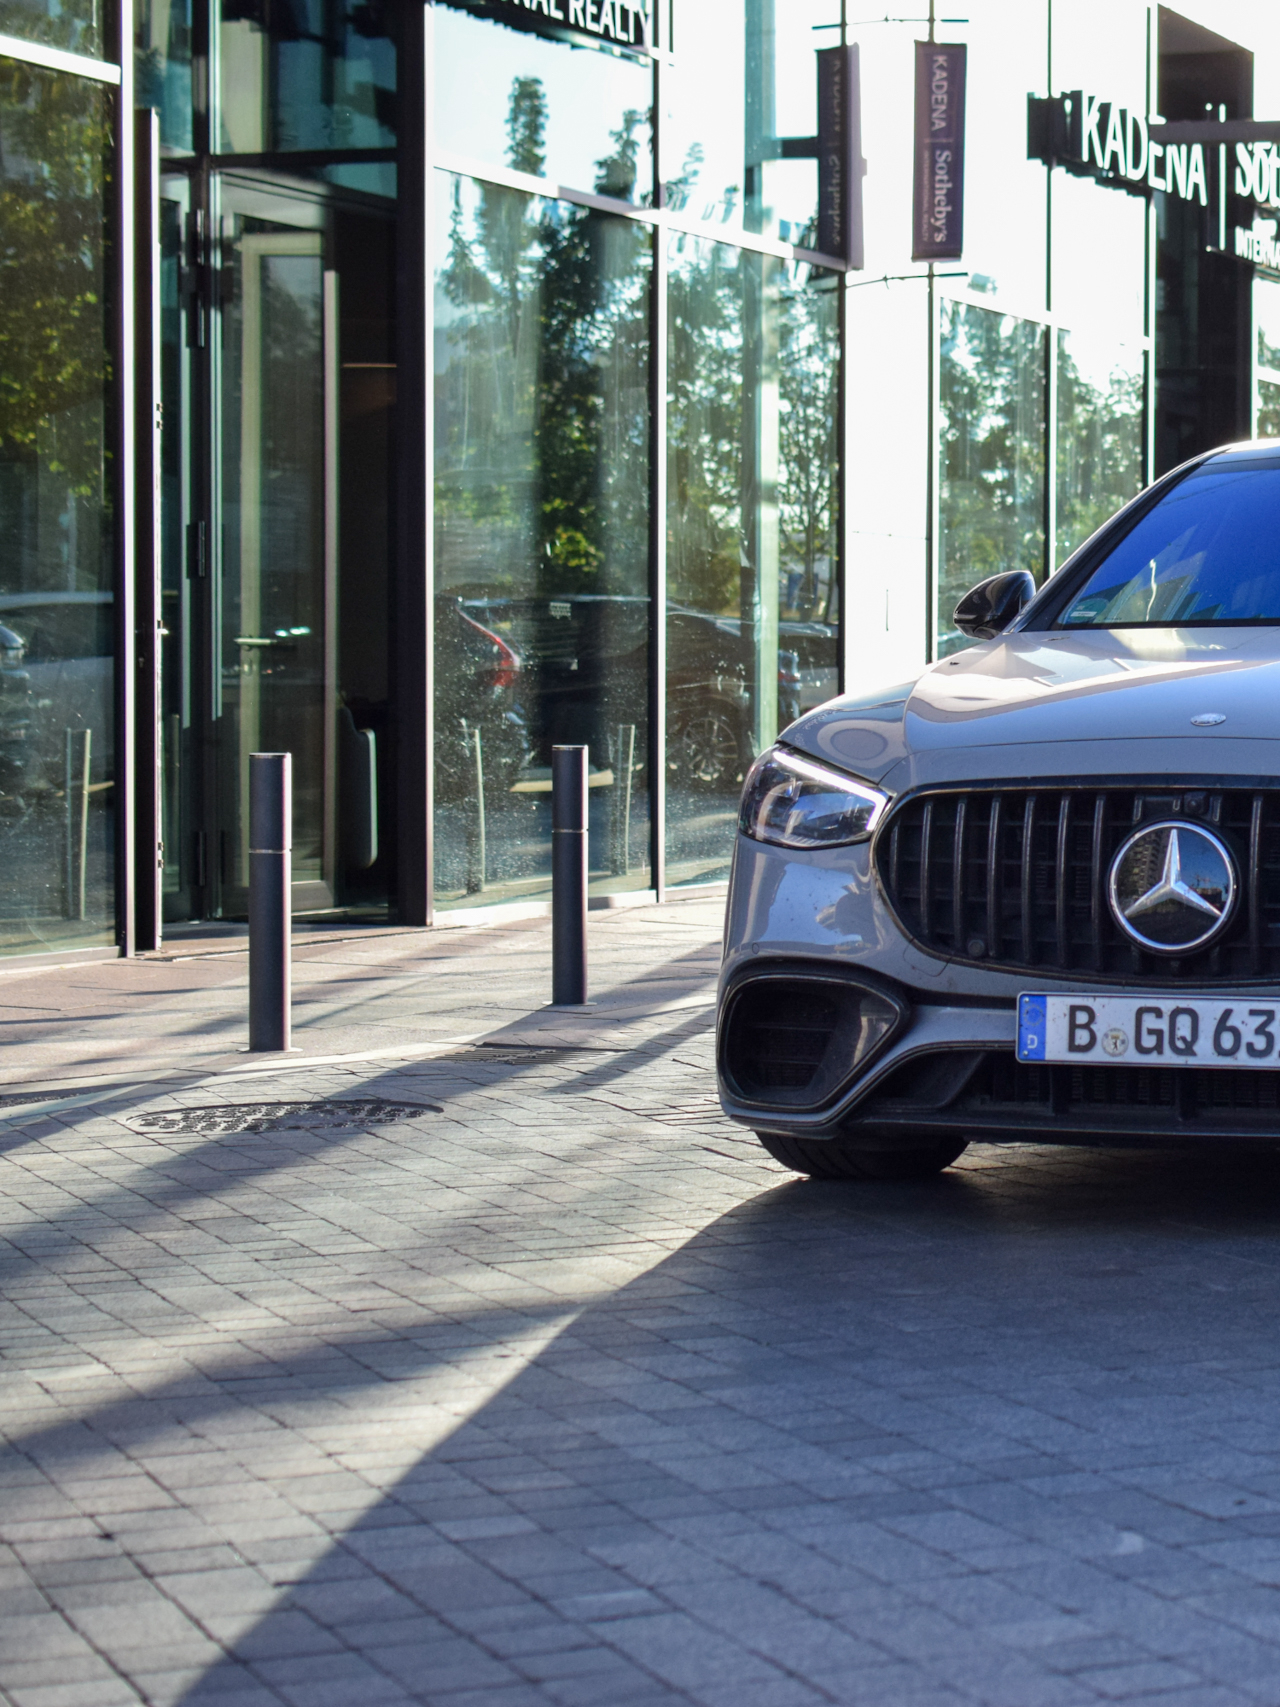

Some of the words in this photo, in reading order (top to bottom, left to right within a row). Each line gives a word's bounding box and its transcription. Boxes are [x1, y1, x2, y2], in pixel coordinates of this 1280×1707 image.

[931, 54, 948, 131] KADENA
[1082, 92, 1207, 207] KADENA
[930, 149, 953, 243] Sotheby's
[1027, 1034, 1039, 1049] D
[1068, 1005, 1098, 1053] B
[1134, 1006, 1199, 1057] GQ
